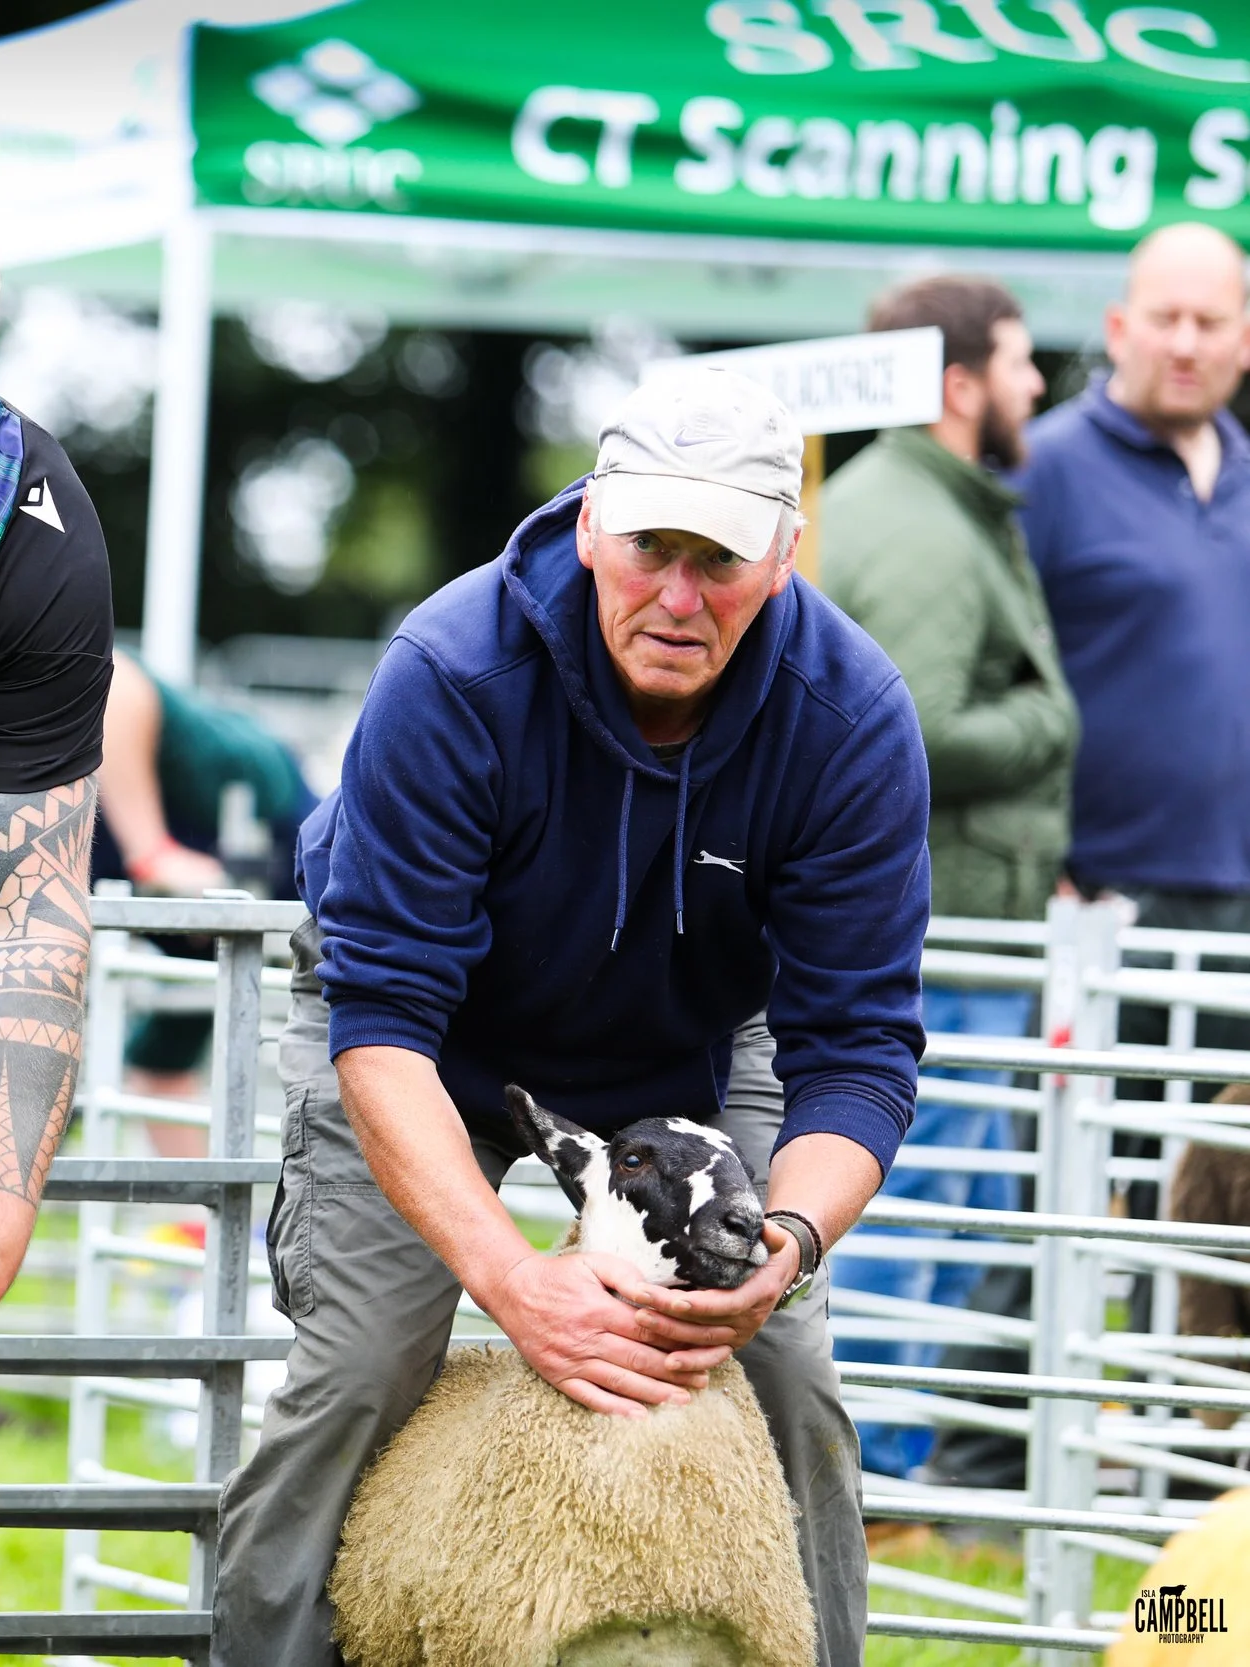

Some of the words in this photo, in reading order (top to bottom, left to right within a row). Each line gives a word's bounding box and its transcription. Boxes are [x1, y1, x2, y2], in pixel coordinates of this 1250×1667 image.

[706, 0, 1250, 84] SRUC
[511, 84, 660, 189] CT
[673, 95, 1157, 230] Scanning
[1184, 107, 1250, 210] S
